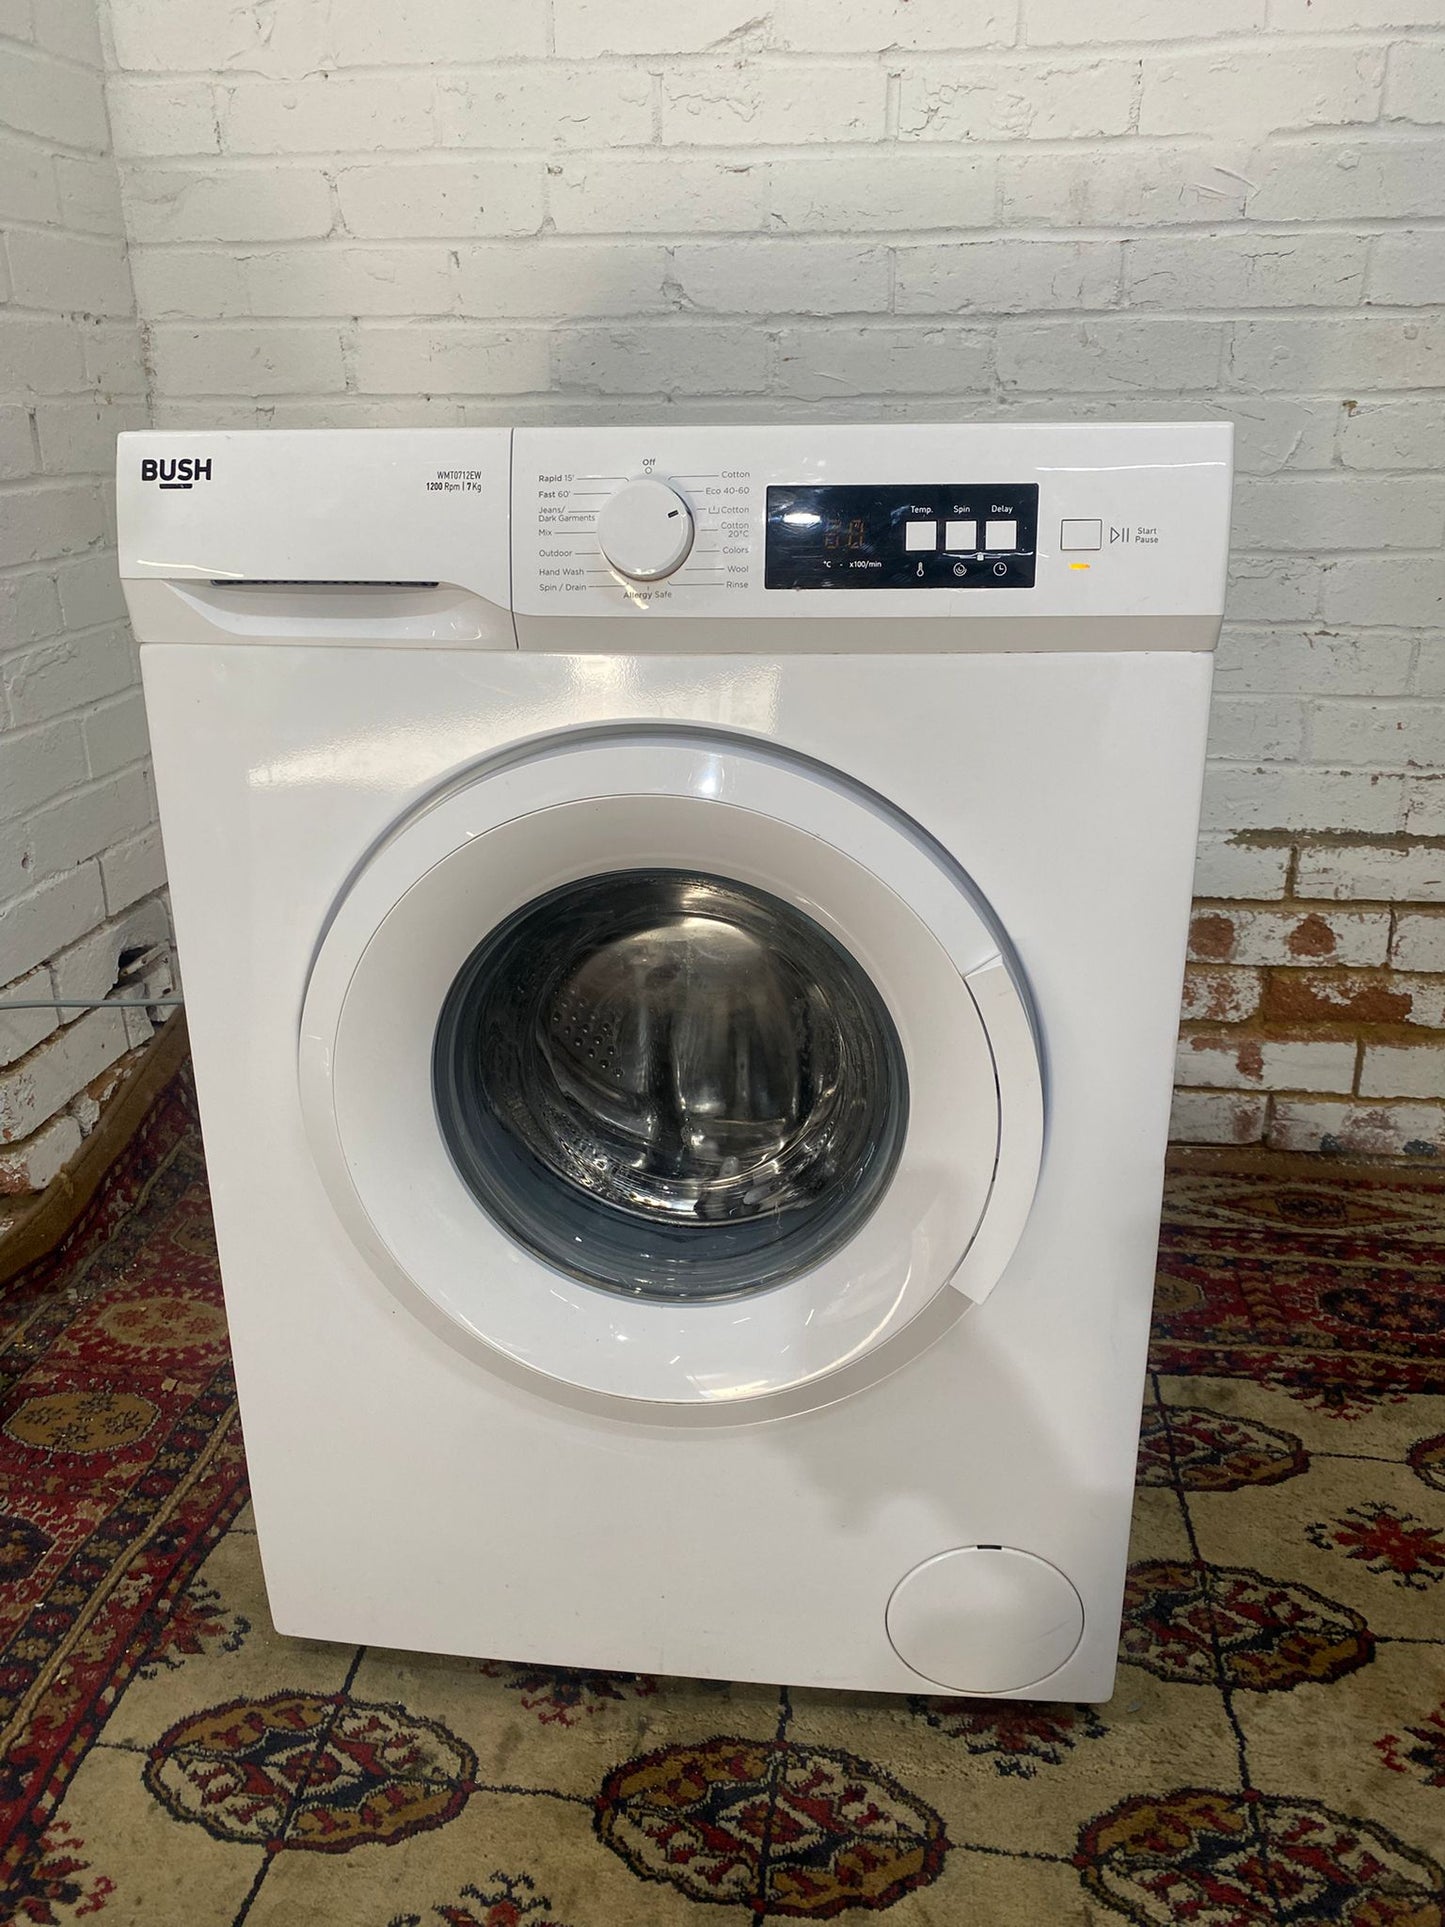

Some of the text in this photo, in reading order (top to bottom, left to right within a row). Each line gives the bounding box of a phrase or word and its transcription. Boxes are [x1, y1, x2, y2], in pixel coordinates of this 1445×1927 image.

[142, 458, 212, 481] BUSH
[436, 470, 482, 480] WMT0712EW
[538, 474, 562, 483] Rapid
[426, 482, 442, 490] 1200
[444, 482, 460, 492] Rpm
[724, 486, 750, 494] 40-60
[538, 506, 566, 514] Jeans/
[910, 505, 934, 514] Temp.
[953, 505, 970, 514] Spin
[991, 504, 1014, 514] Delay
[558, 514, 596, 522] Garments
[728, 530, 749, 538] 20°C
[1137, 526, 1157, 534] Start
[1135, 536, 1158, 544] Pause
[538, 549, 572, 557] Outdoor
[722, 546, 750, 554] Colors
[849, 560, 882, 569] x100/min
[562, 568, 584, 576] Wash
[539, 584, 556, 592] Spin
[623, 590, 672, 600] Allergy Safe
